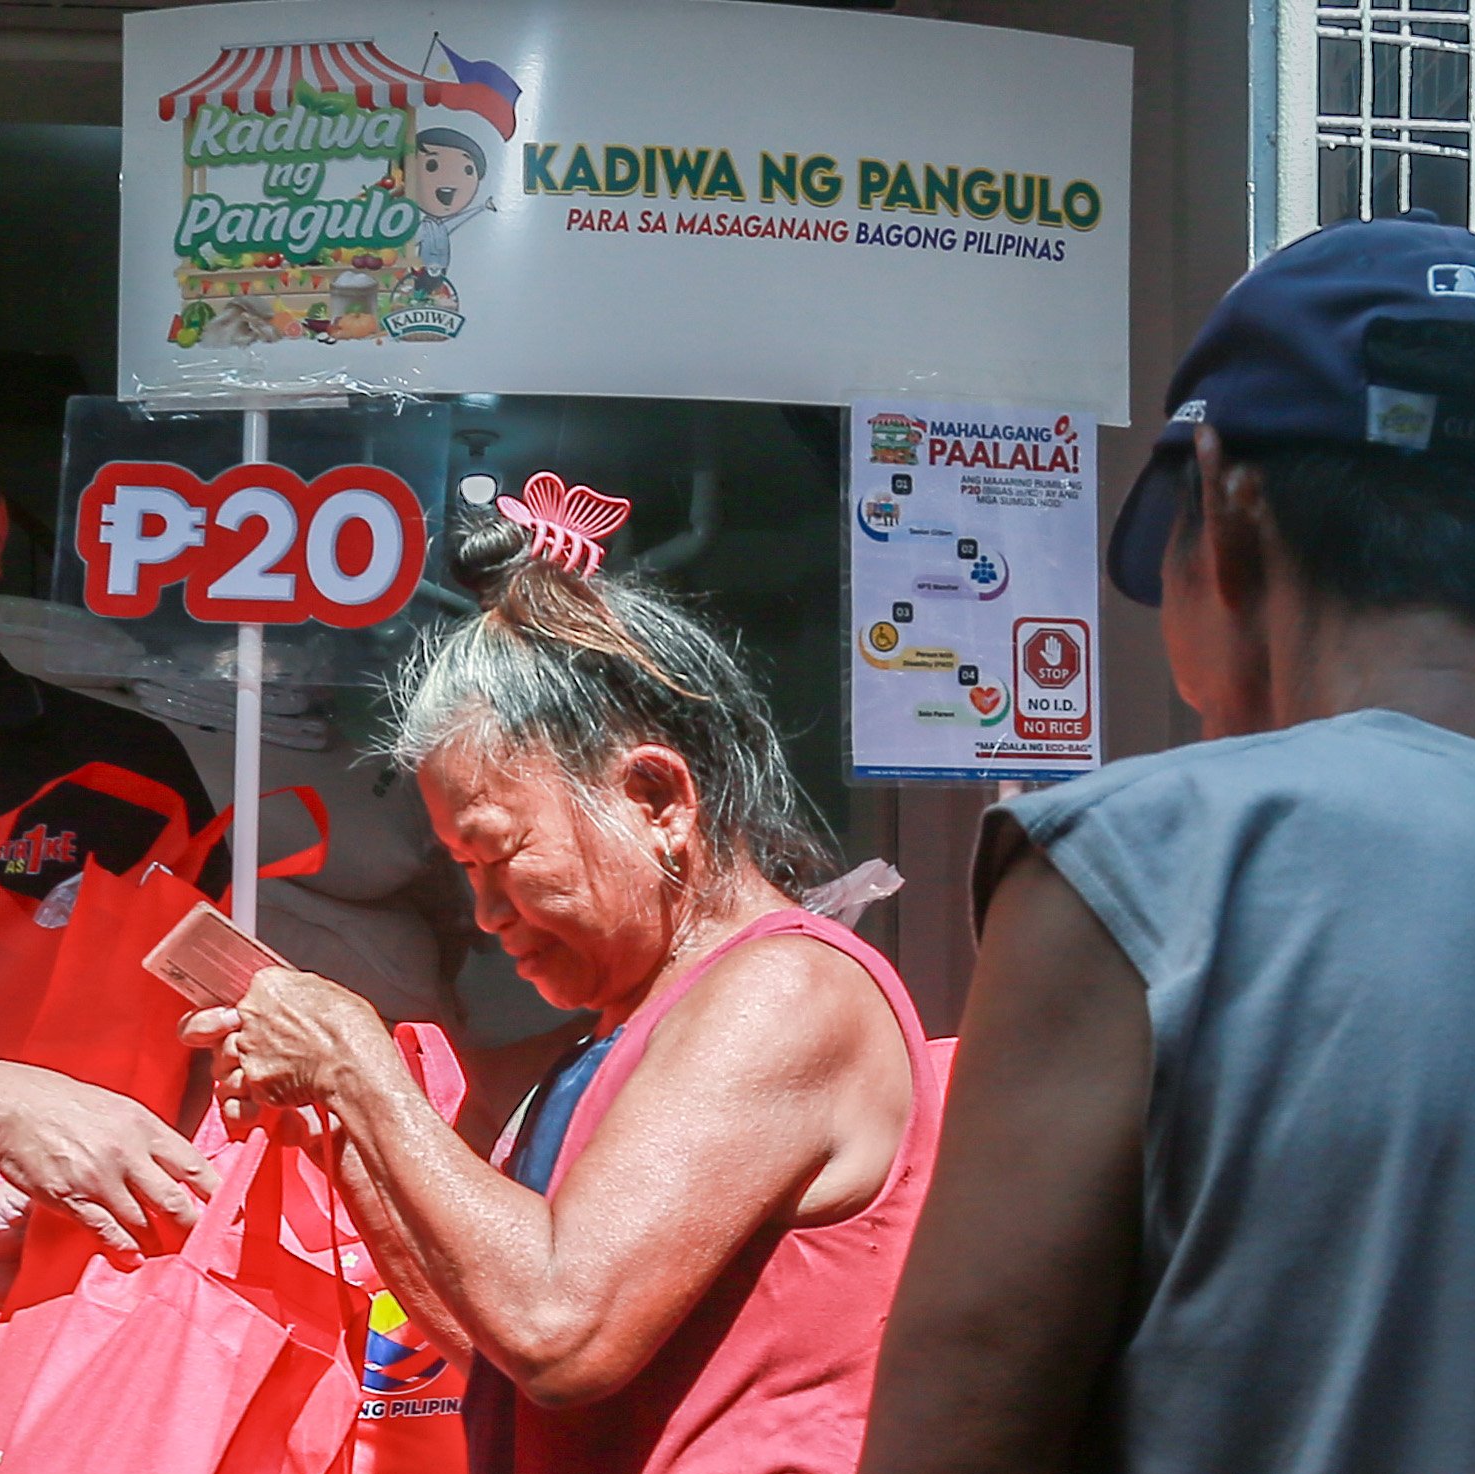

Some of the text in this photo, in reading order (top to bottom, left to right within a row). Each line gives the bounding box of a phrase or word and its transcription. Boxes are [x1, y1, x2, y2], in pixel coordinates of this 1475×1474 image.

[189, 104, 403, 158] Kadiwa
[268, 161, 321, 197] ng
[523, 143, 1103, 232] KADIWA NG PANGULO
[179, 189, 415, 255] Pangulo
[566, 208, 1066, 262] PARA SA MASAGANANG BAGONG PILIPINAS
[389, 311, 457, 332] KADIWA
[930, 421, 1052, 442] MAHALAGANG
[928, 438, 1079, 474] PAALALA!
[895, 607, 910, 617] 03
[961, 670, 975, 680] 04
[1038, 667, 1070, 679] STOP
[1028, 698, 1077, 712] NO I.D.
[1023, 721, 1083, 735] NO RICE
[389, 1398, 463, 1417] PILIPIN
